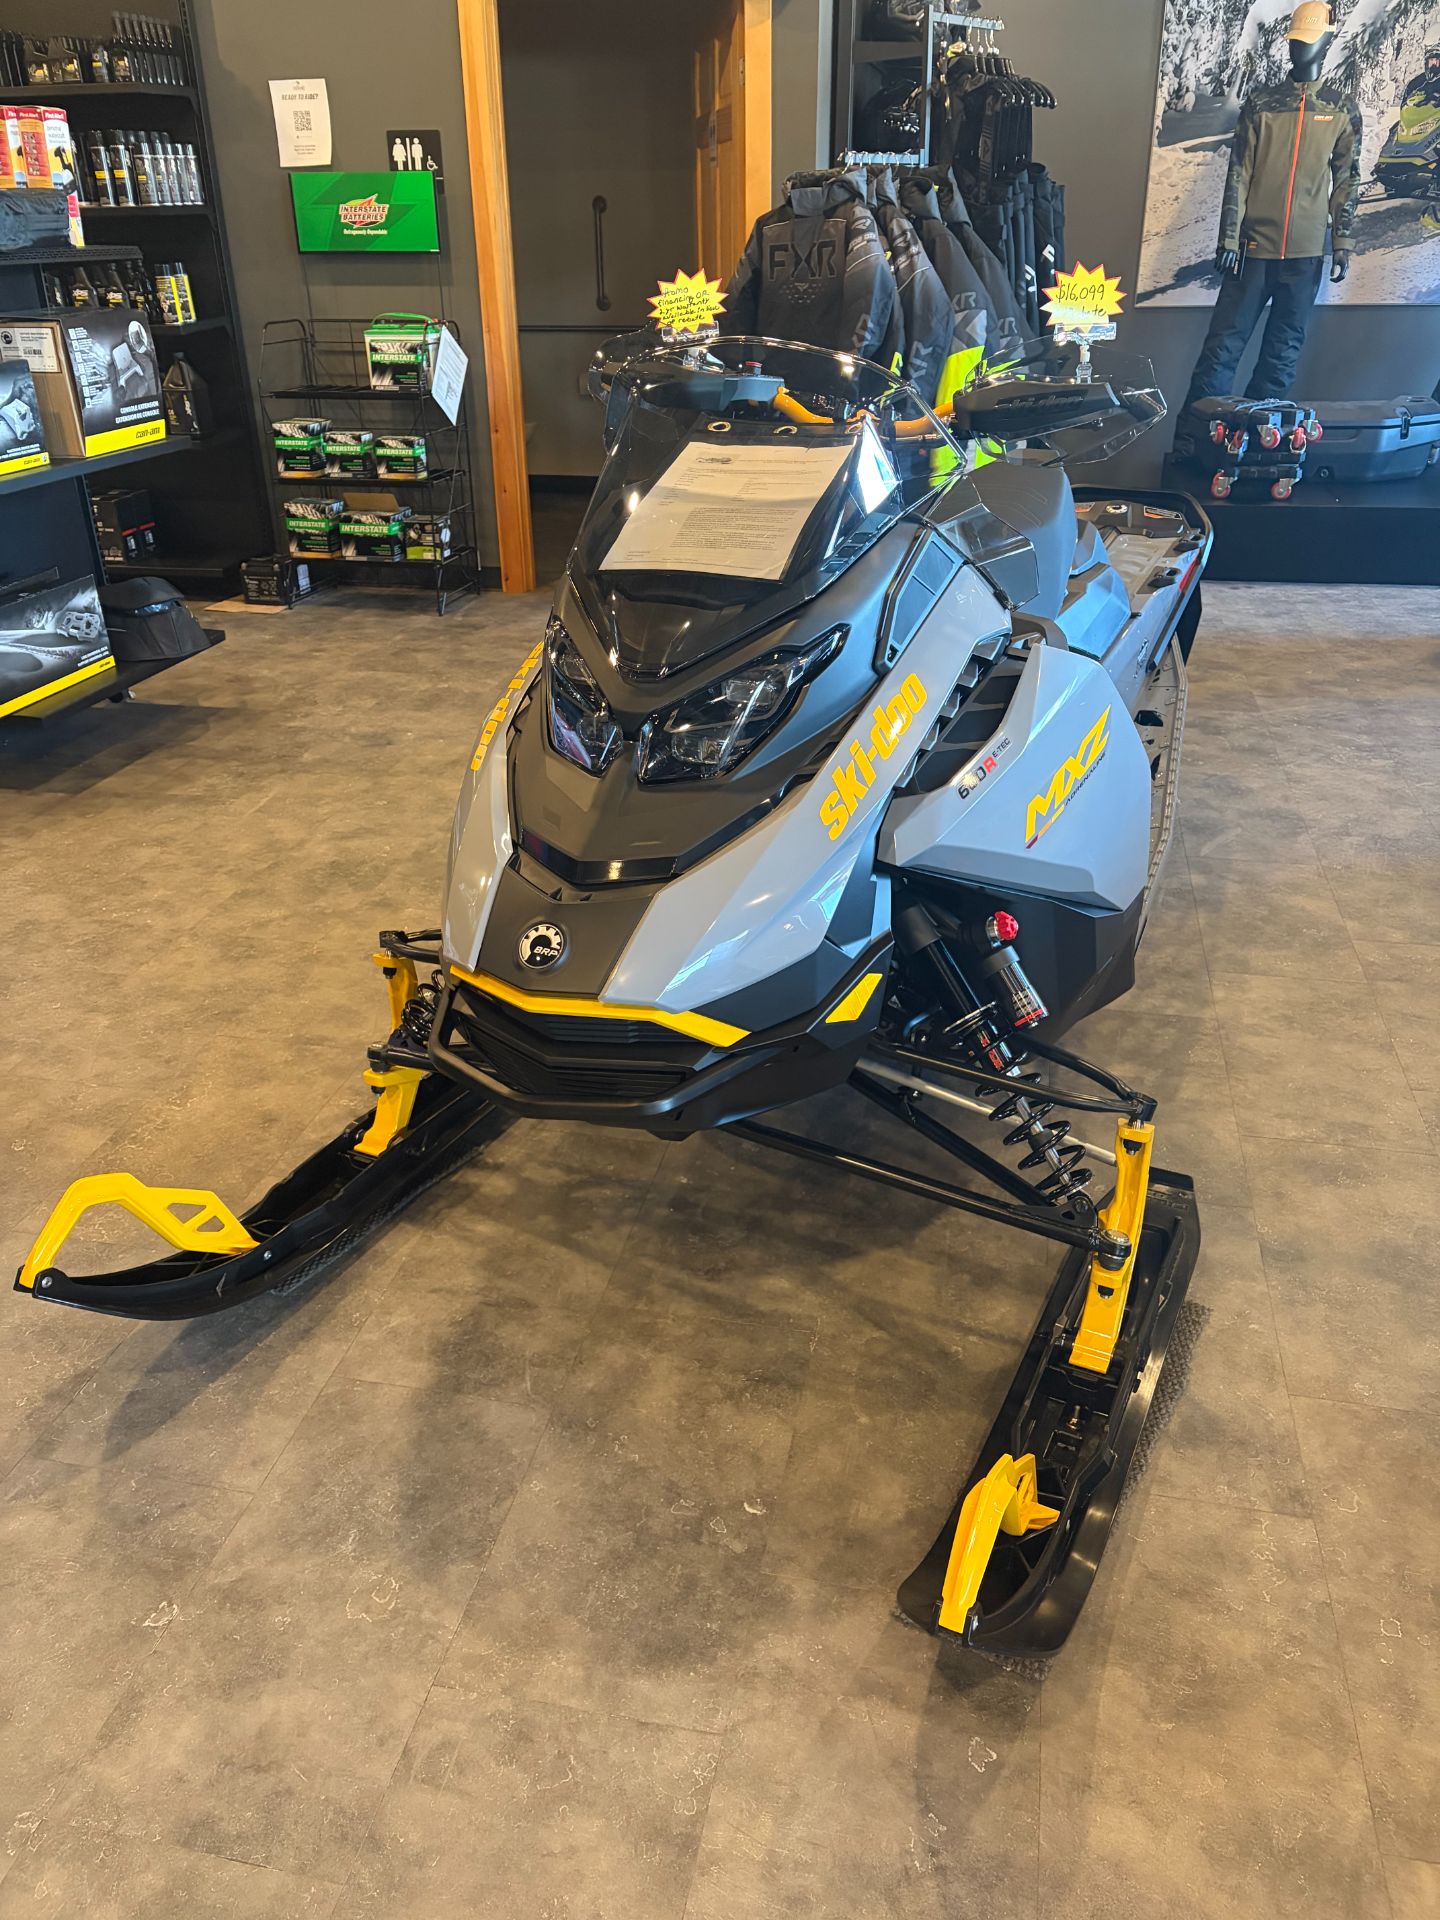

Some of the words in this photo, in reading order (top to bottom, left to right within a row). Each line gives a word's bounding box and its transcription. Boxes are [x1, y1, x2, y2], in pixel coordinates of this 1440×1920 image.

[342, 213, 384, 221] BATTERIES
[768, 239, 838, 282] FXR
[1055, 279, 1106, 303] $16,099
[135, 427, 160, 439] can-am
[288, 520, 326, 528] INTERSTATE
[341, 525, 389, 533] INTERSTATE
[819, 672, 928, 842] ski-doo
[1024, 703, 1112, 844] MXZ
[1064, 750, 1107, 806] ADRENALINE
[533, 946, 559, 957] BRP
